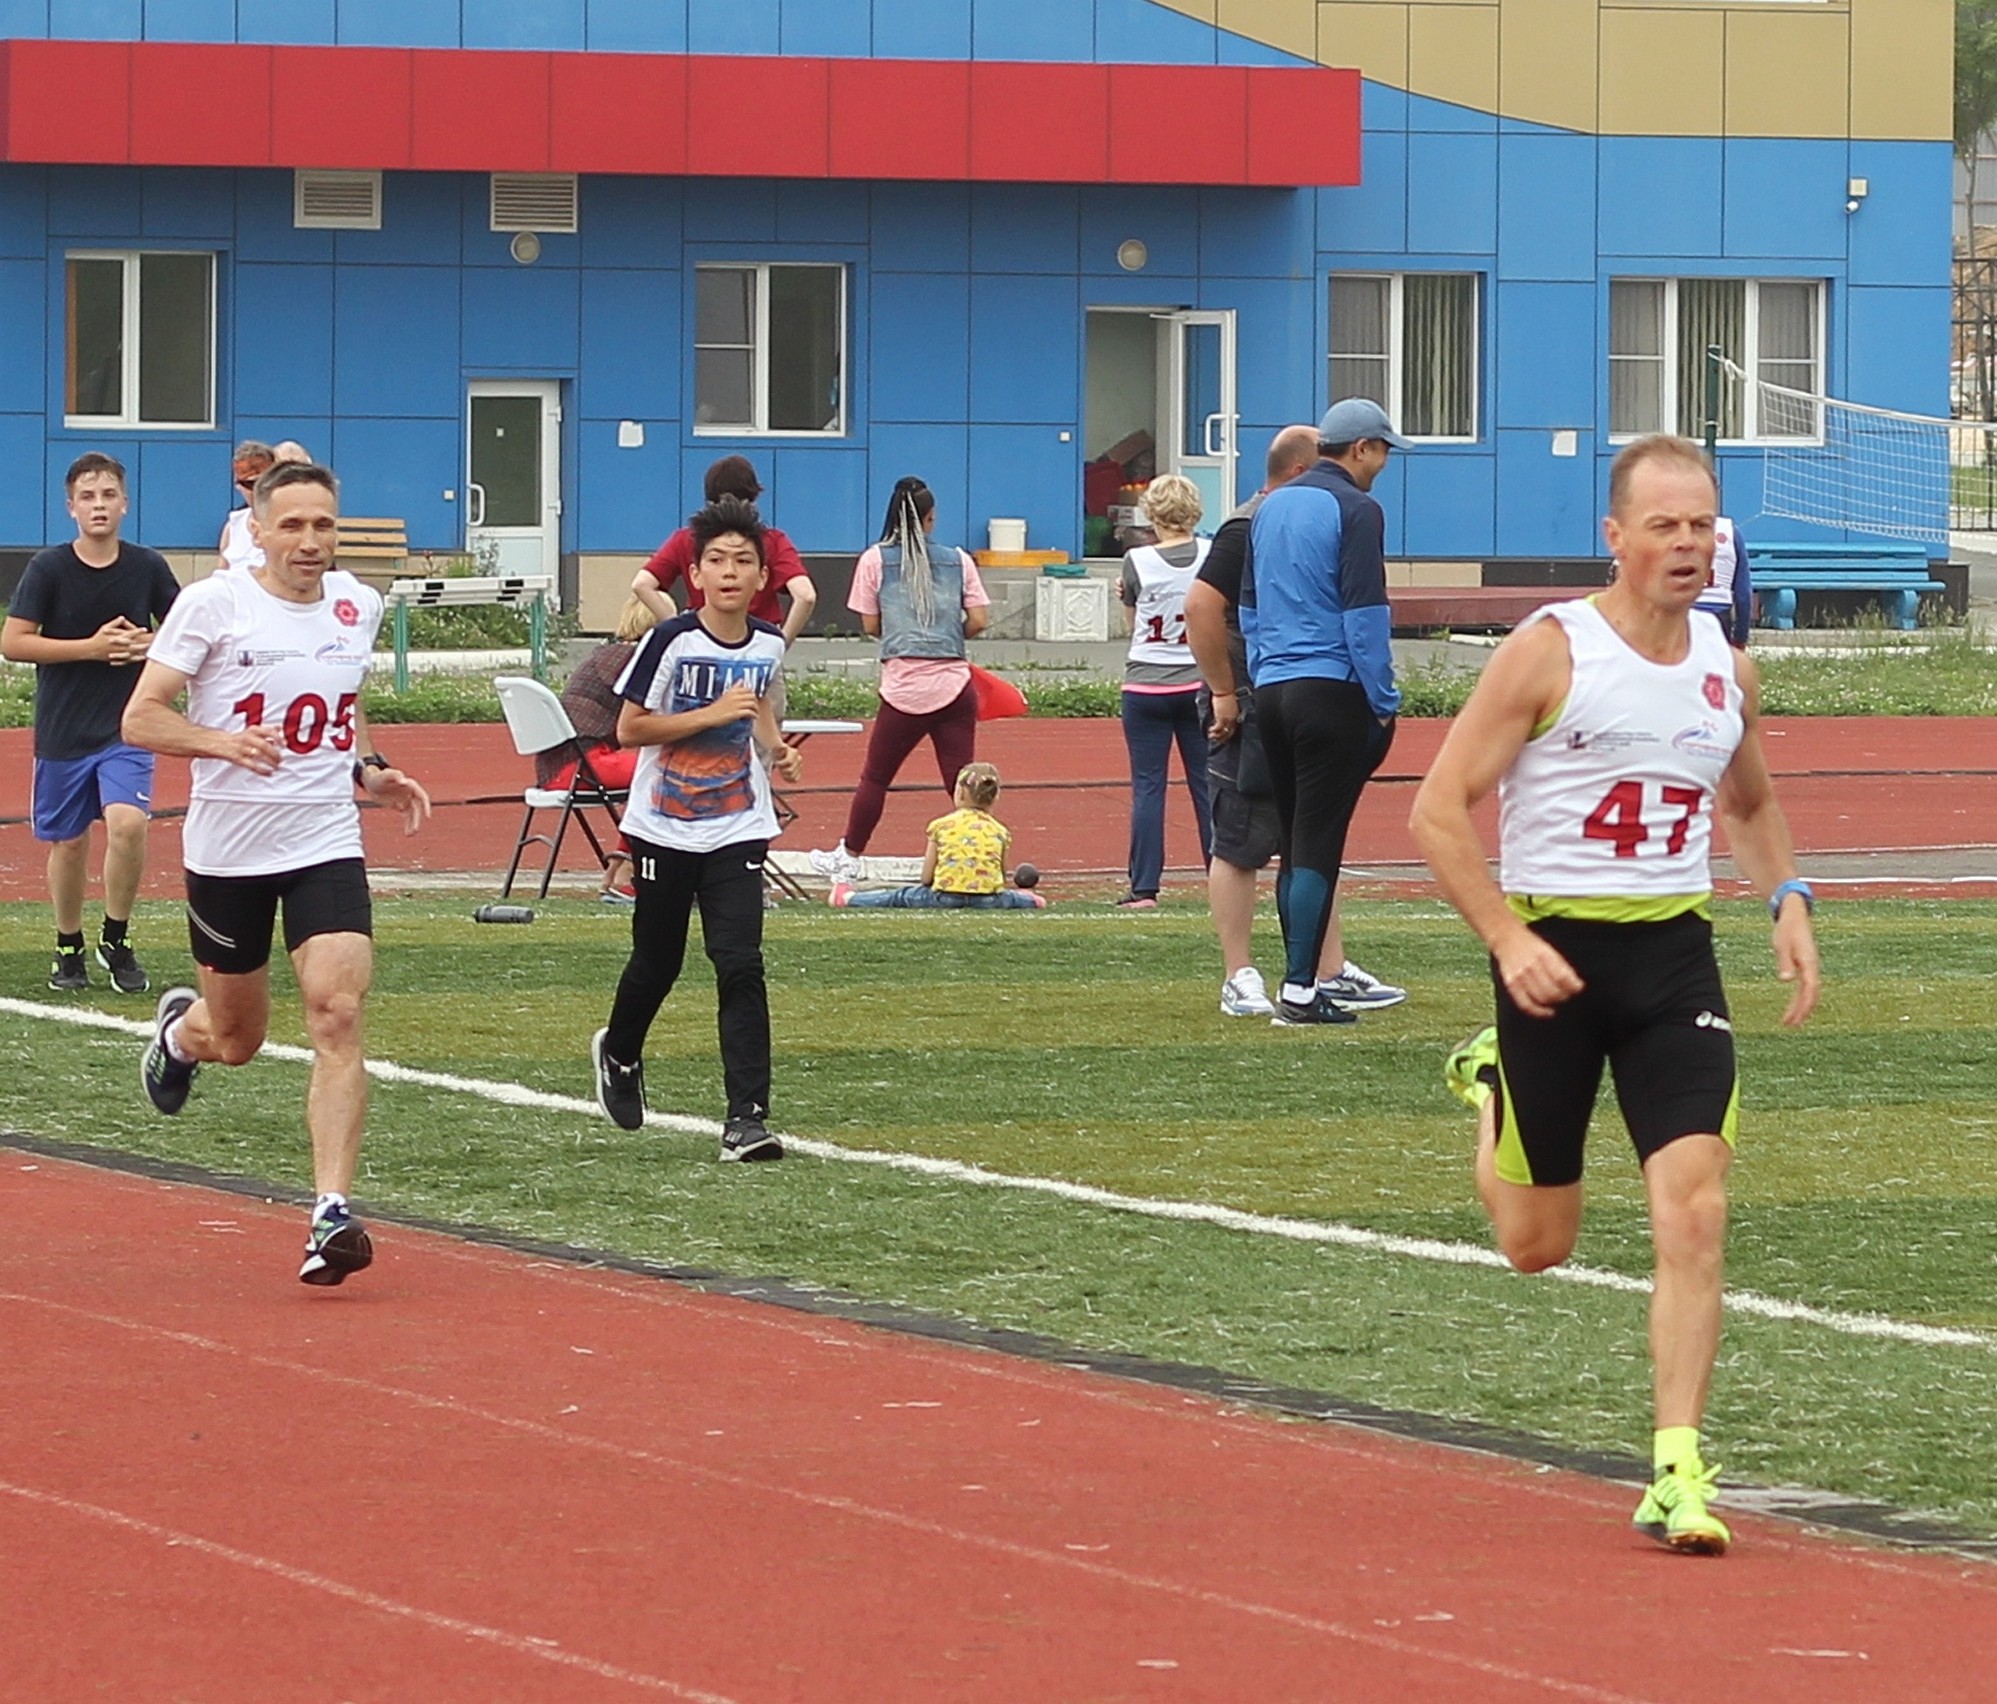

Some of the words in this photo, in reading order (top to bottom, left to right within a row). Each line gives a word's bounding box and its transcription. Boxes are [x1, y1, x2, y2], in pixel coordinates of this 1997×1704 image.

[679, 664, 769, 698] MIAMI
[233, 692, 358, 754] 105
[1583, 781, 1705, 857] 47
[641, 856, 656, 881] 11
